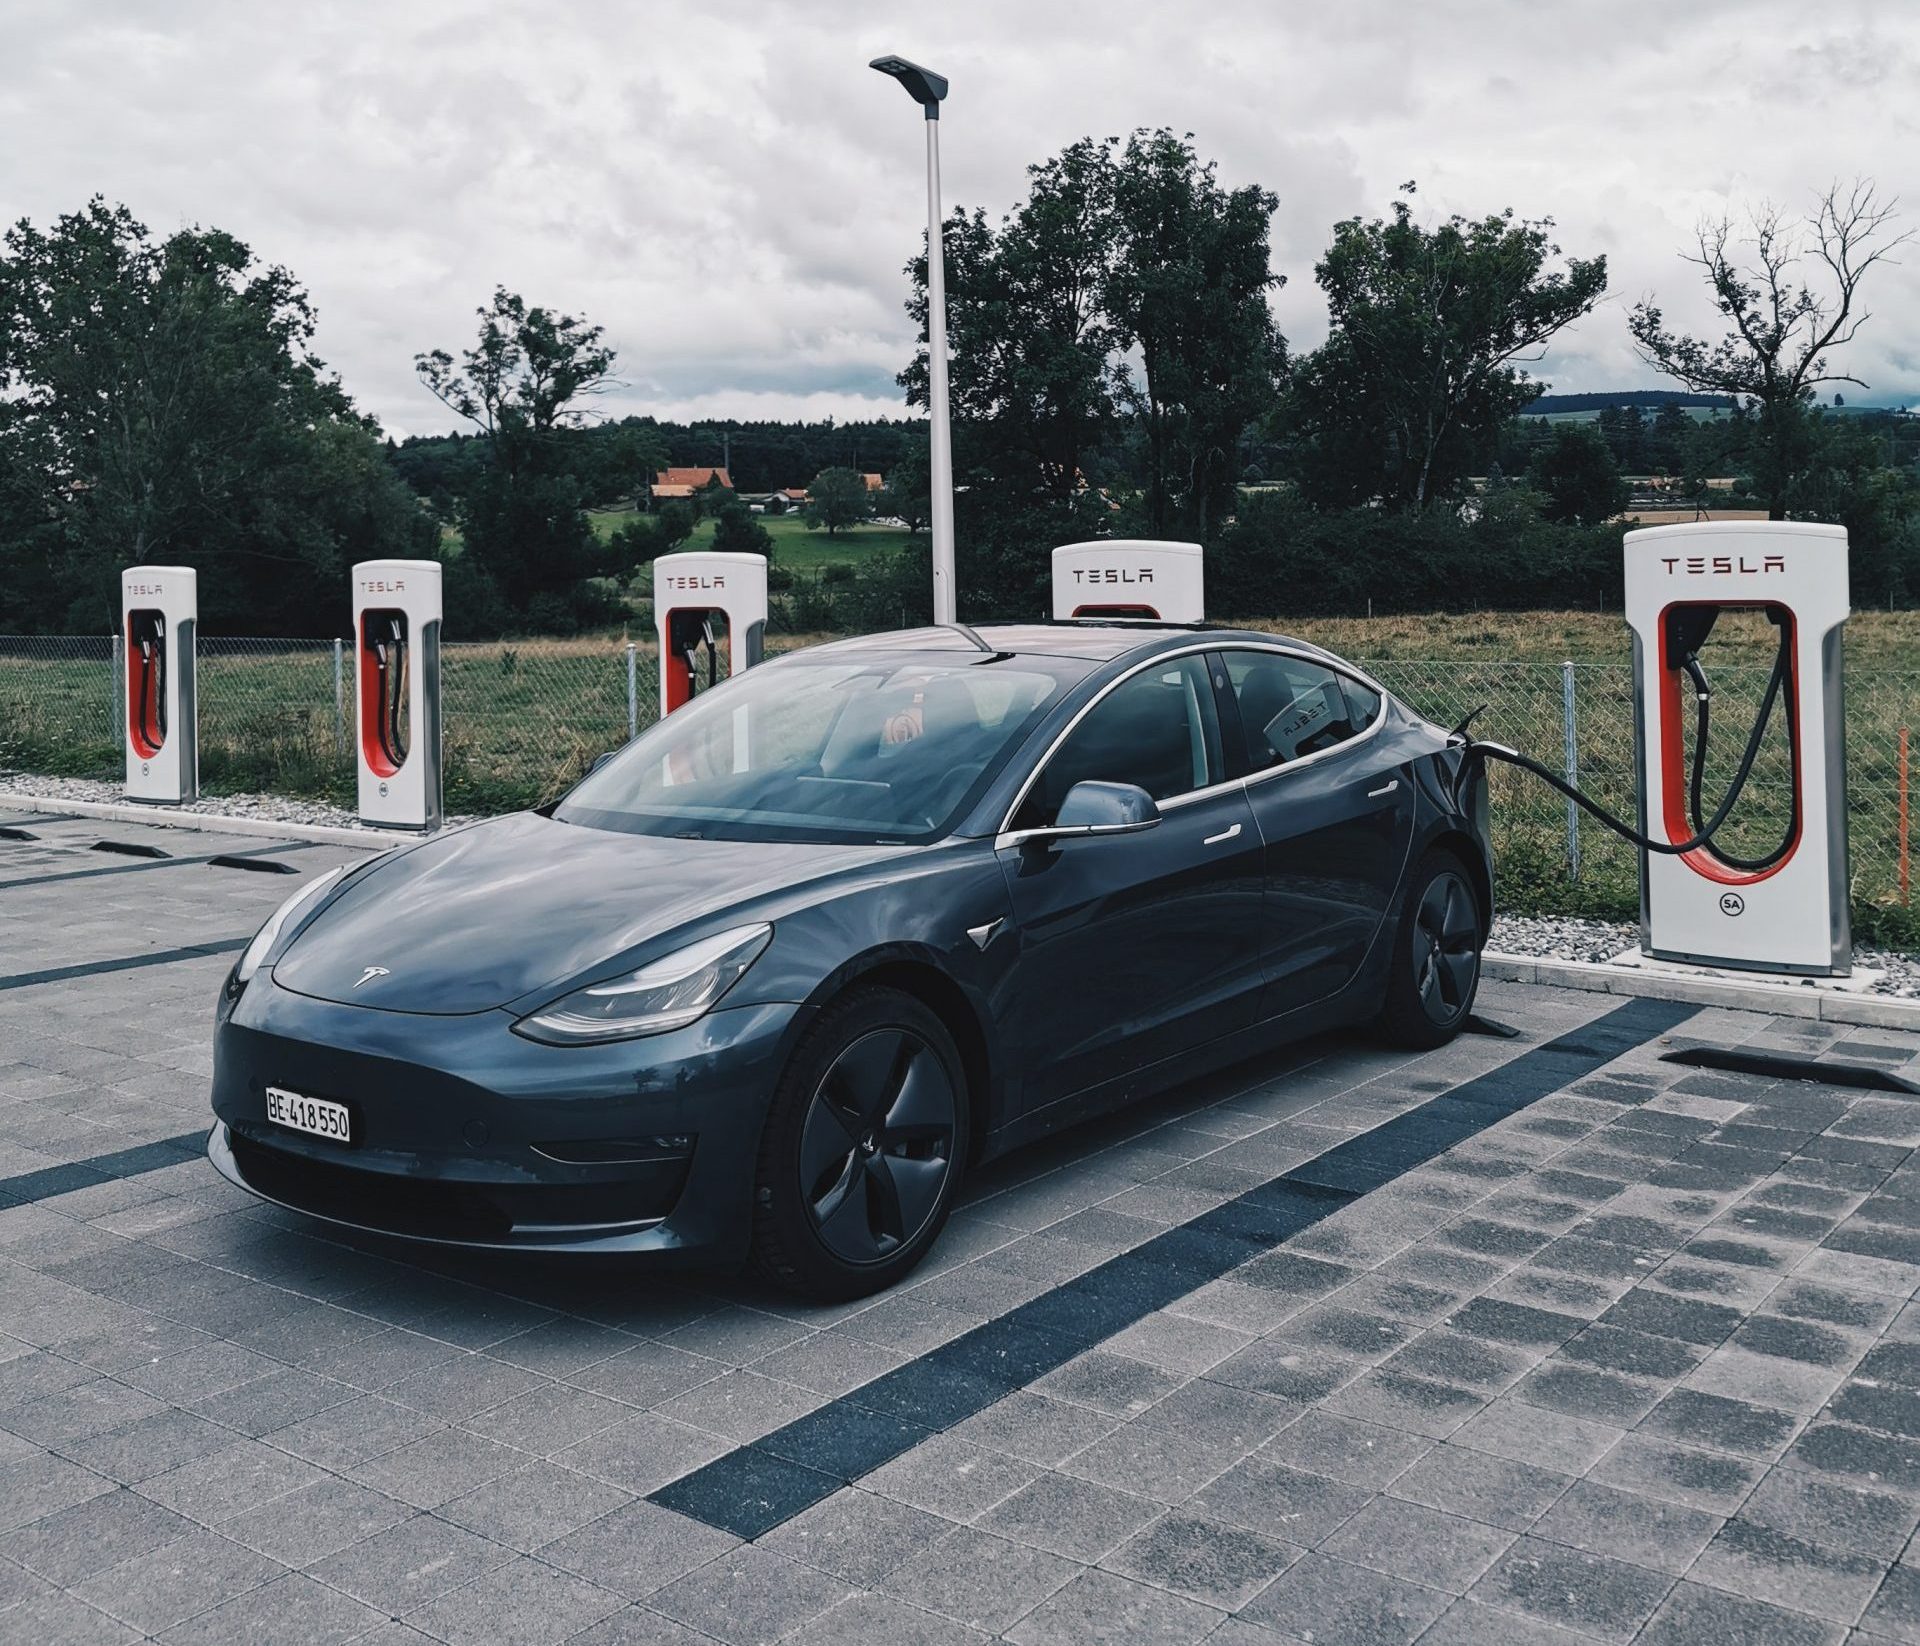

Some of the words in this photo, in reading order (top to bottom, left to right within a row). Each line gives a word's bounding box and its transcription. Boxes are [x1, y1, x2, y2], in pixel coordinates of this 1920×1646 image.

[1660, 556, 1784, 574] TESLA
[1072, 568, 1153, 583] TESLA
[361, 581, 405, 592] TESLA
[666, 576, 724, 589] TESLA
[127, 584, 163, 595] TESLA
[1724, 899, 1741, 909] 5A
